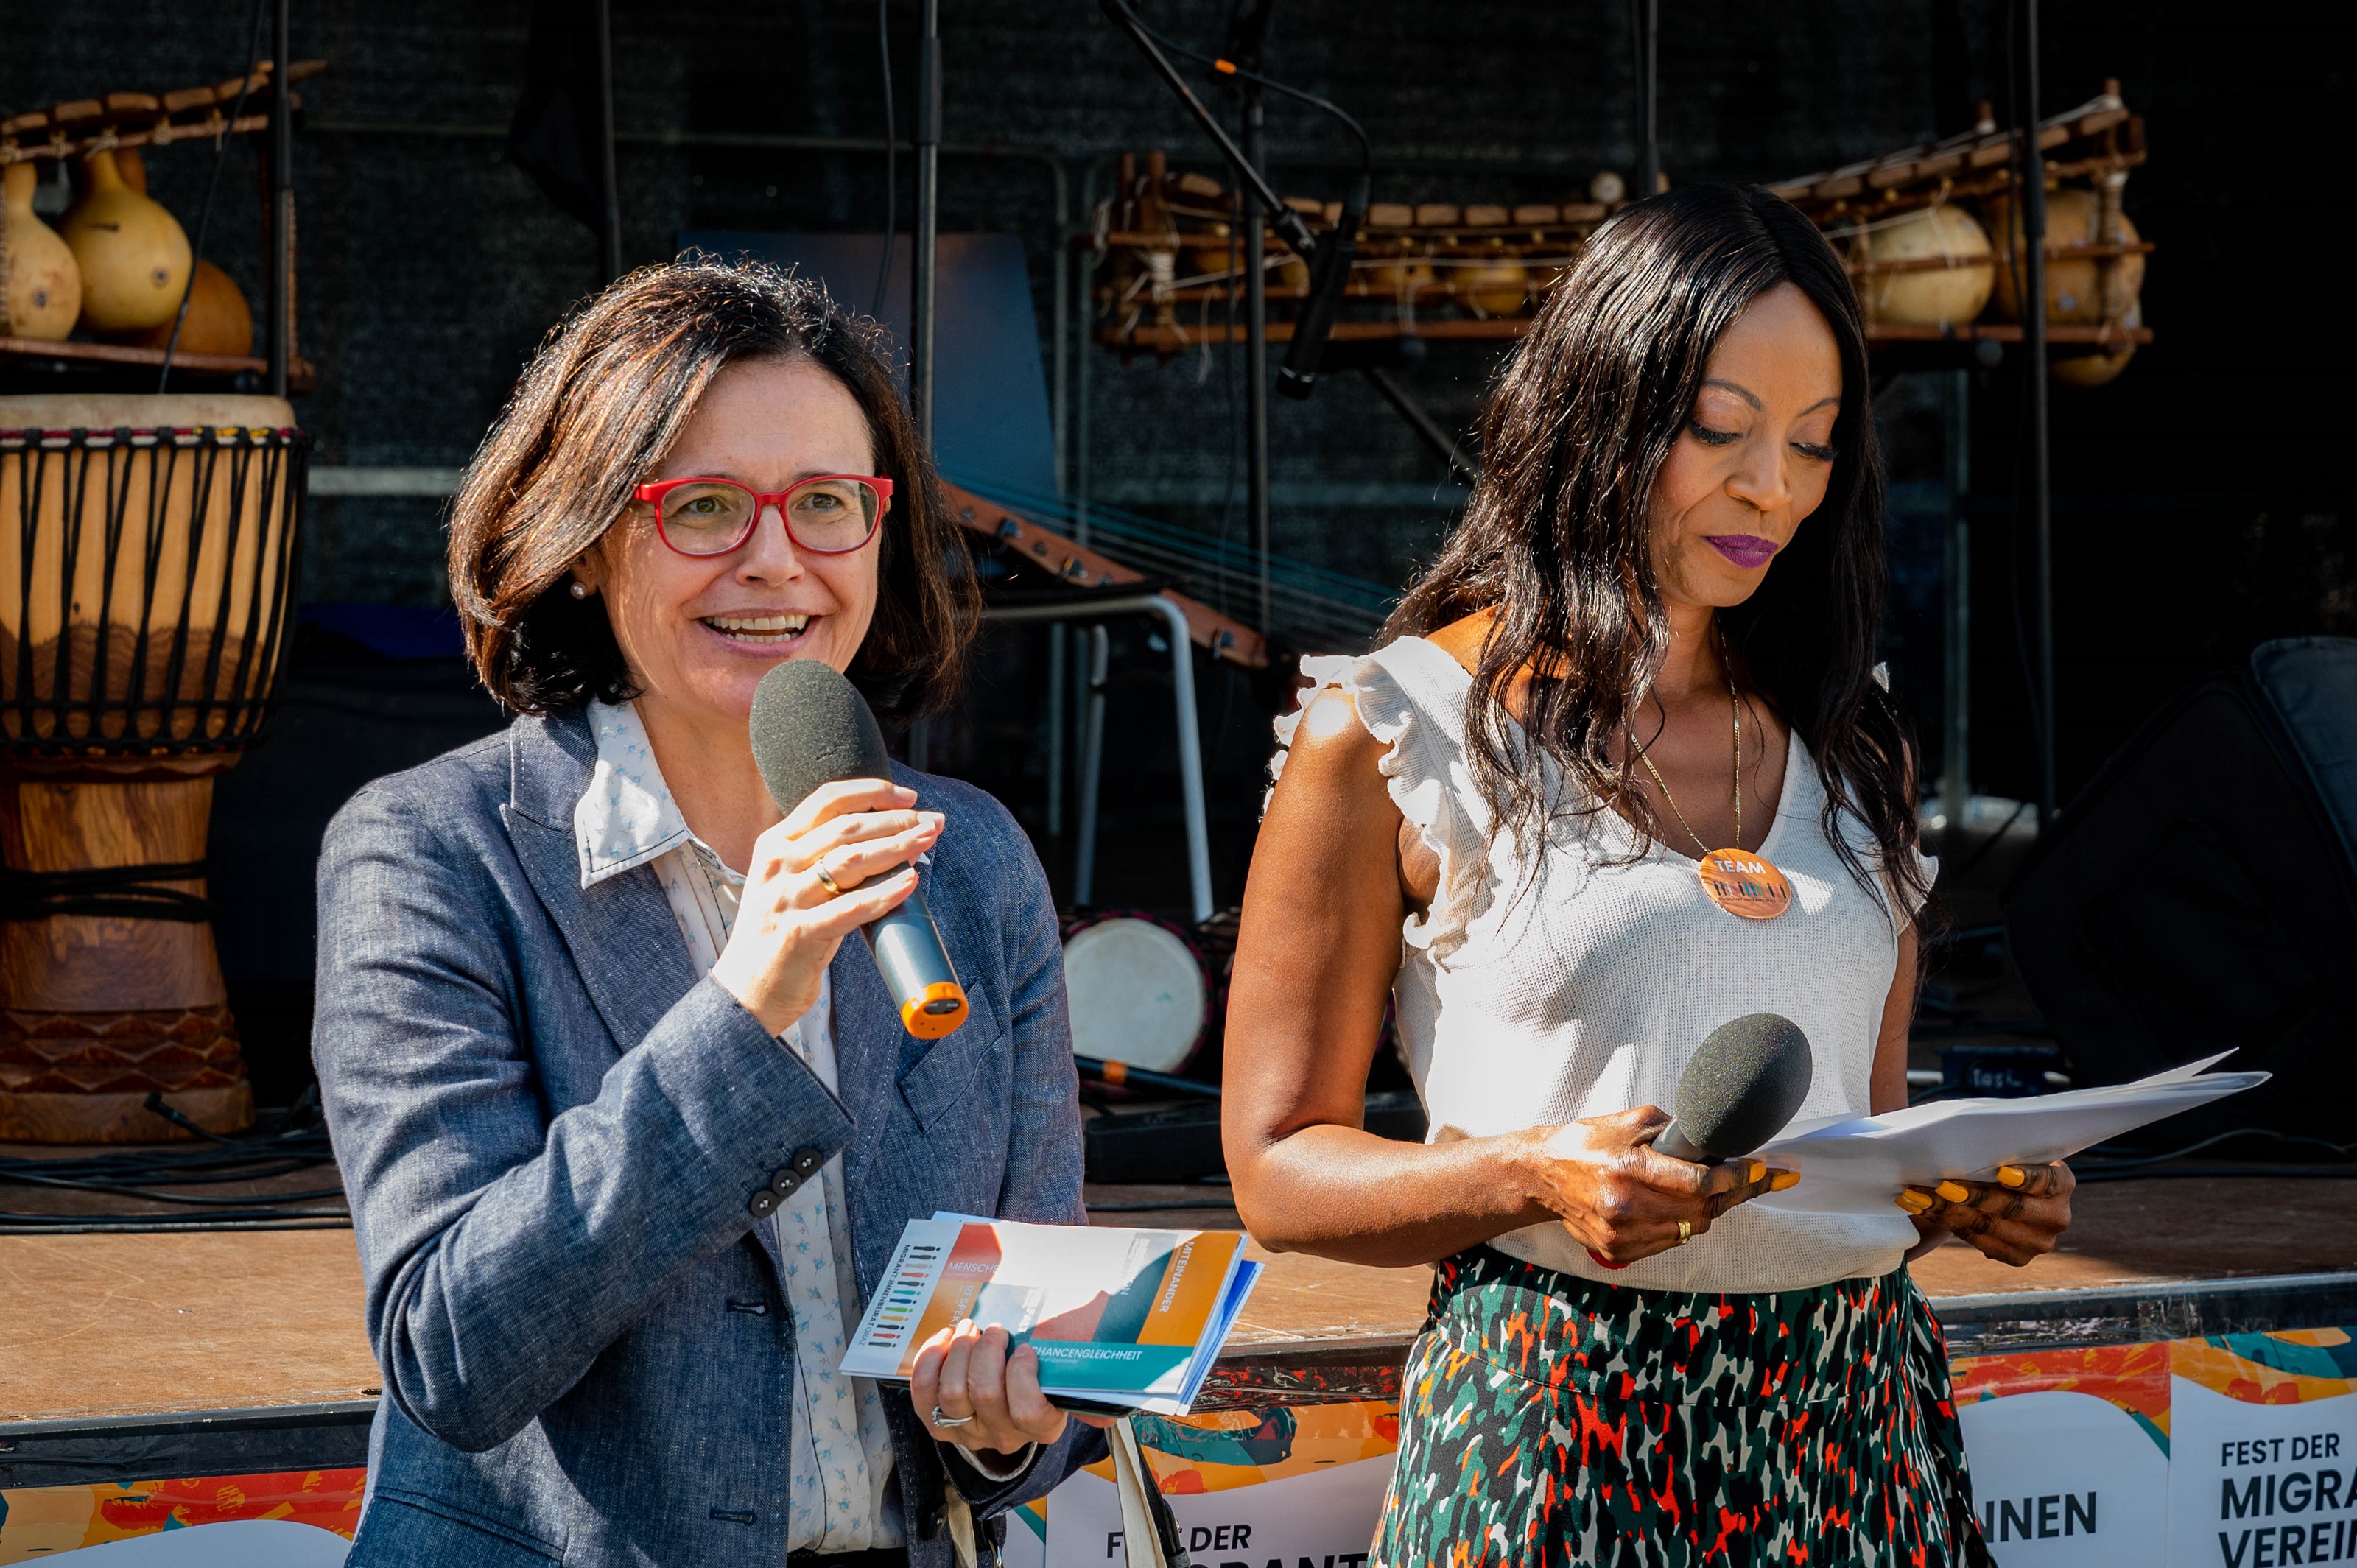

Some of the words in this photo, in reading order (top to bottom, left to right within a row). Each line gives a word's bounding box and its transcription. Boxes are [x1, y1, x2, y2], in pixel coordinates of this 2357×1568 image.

[1714, 860, 1766, 874] TEAM
[1159, 1241, 1195, 1312] MITEINANDER
[858, 1326, 872, 1346] GRAZ
[2221, 1438, 2285, 1467] FEST
[2291, 1433, 2340, 1461] DER
[1190, 1524, 1252, 1553] DER
